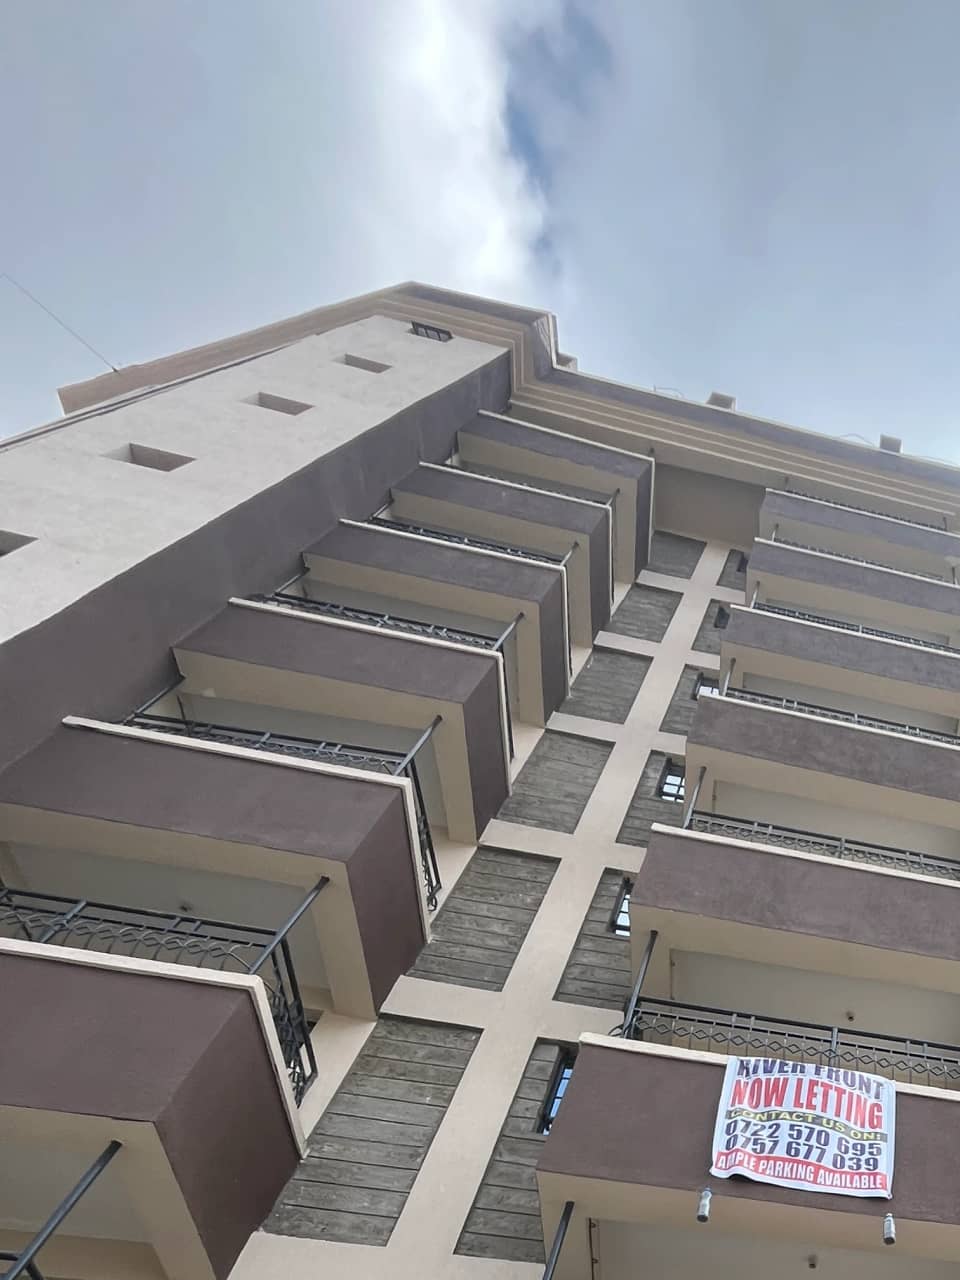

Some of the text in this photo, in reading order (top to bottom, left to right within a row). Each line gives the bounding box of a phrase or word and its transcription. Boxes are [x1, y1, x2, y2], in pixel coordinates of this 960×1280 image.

[730, 1077, 883, 1130] NOW LETTING
[725, 1119, 882, 1156] 0722 570 695
[731, 1109, 881, 1141] CONTACT US ON:
[717, 1151, 883, 1189] AMPLE PARKING AVAILABLE
[725, 1134, 879, 1171] 0757 677 039
